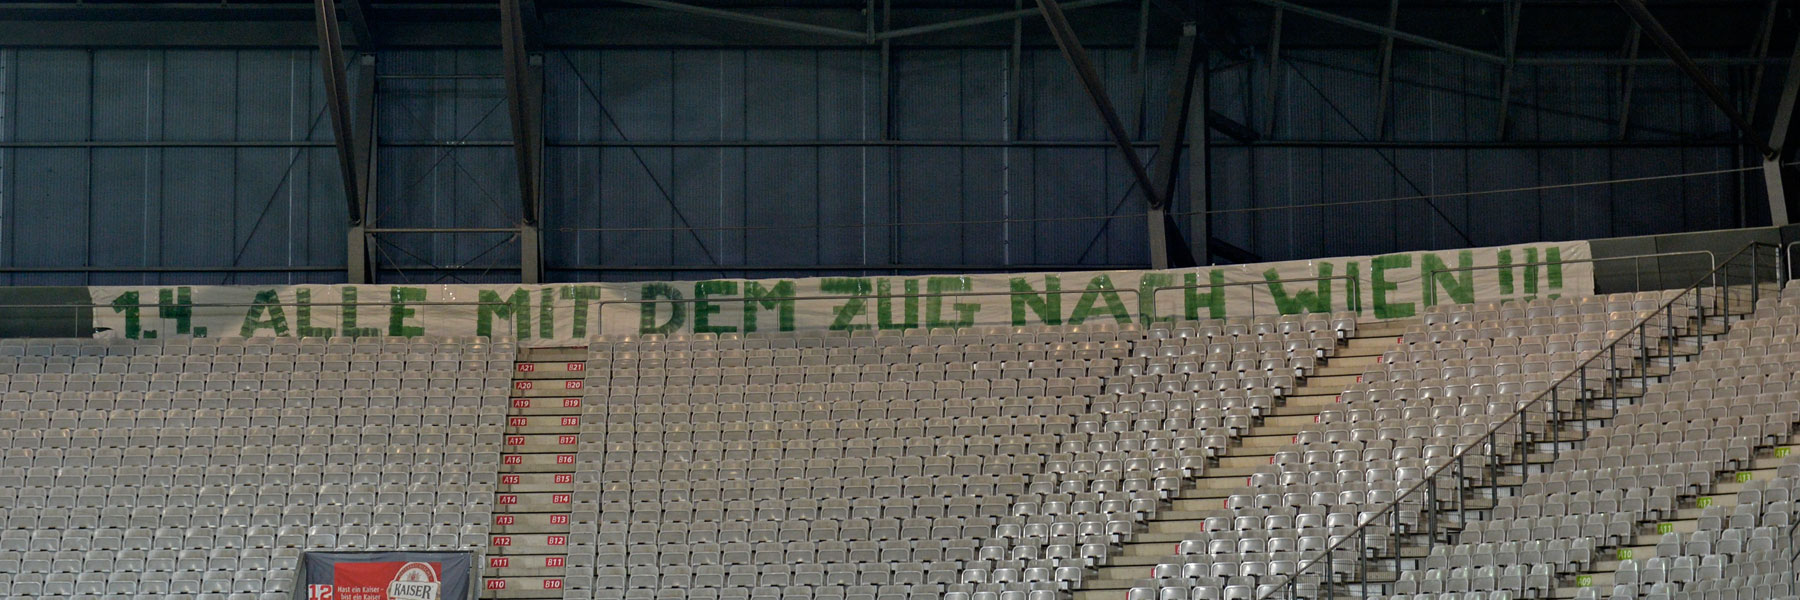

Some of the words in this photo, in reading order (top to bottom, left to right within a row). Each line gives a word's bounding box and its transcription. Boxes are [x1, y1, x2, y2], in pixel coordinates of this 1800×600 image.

[112, 286, 208, 339] 1.4.
[239, 286, 427, 339] ALLE
[476, 286, 602, 340] MIT
[640, 279, 796, 336] DEM
[820, 276, 982, 332] ZUG
[1010, 268, 1226, 328] NACH
[1262, 249, 1476, 320] WIEN
[1498, 246, 1563, 306] !!!
[520, 364, 533, 372] A21
[569, 363, 583, 371] B21
[518, 382, 532, 390] A20
[567, 381, 581, 389] B20
[515, 400, 530, 408] A19
[565, 399, 579, 407] B19
[512, 418, 527, 426] A18
[563, 417, 577, 426] B18
[510, 437, 524, 445] A17
[560, 436, 575, 444] B17
[1775, 449, 1790, 458] A14
[507, 456, 521, 464] A16
[559, 455, 573, 464] B16
[504, 476, 519, 484] A15
[556, 475, 571, 483] B15
[1737, 472, 1751, 482] A13
[502, 496, 517, 504] A14
[554, 495, 569, 503] B14
[1698, 498, 1711, 507] A12
[498, 516, 513, 525] A13
[552, 515, 567, 524] B13
[1658, 524, 1672, 533] A11
[495, 537, 511, 546] A12
[549, 536, 564, 545] B12
[1618, 549, 1632, 560] A10
[493, 558, 508, 567] A11
[547, 558, 563, 567] B11
[489, 580, 505, 589] A10
[545, 580, 561, 589] B10
[1577, 577, 1591, 587] A09
[309, 585, 332, 600] 12
[394, 583, 432, 599] KAISER
